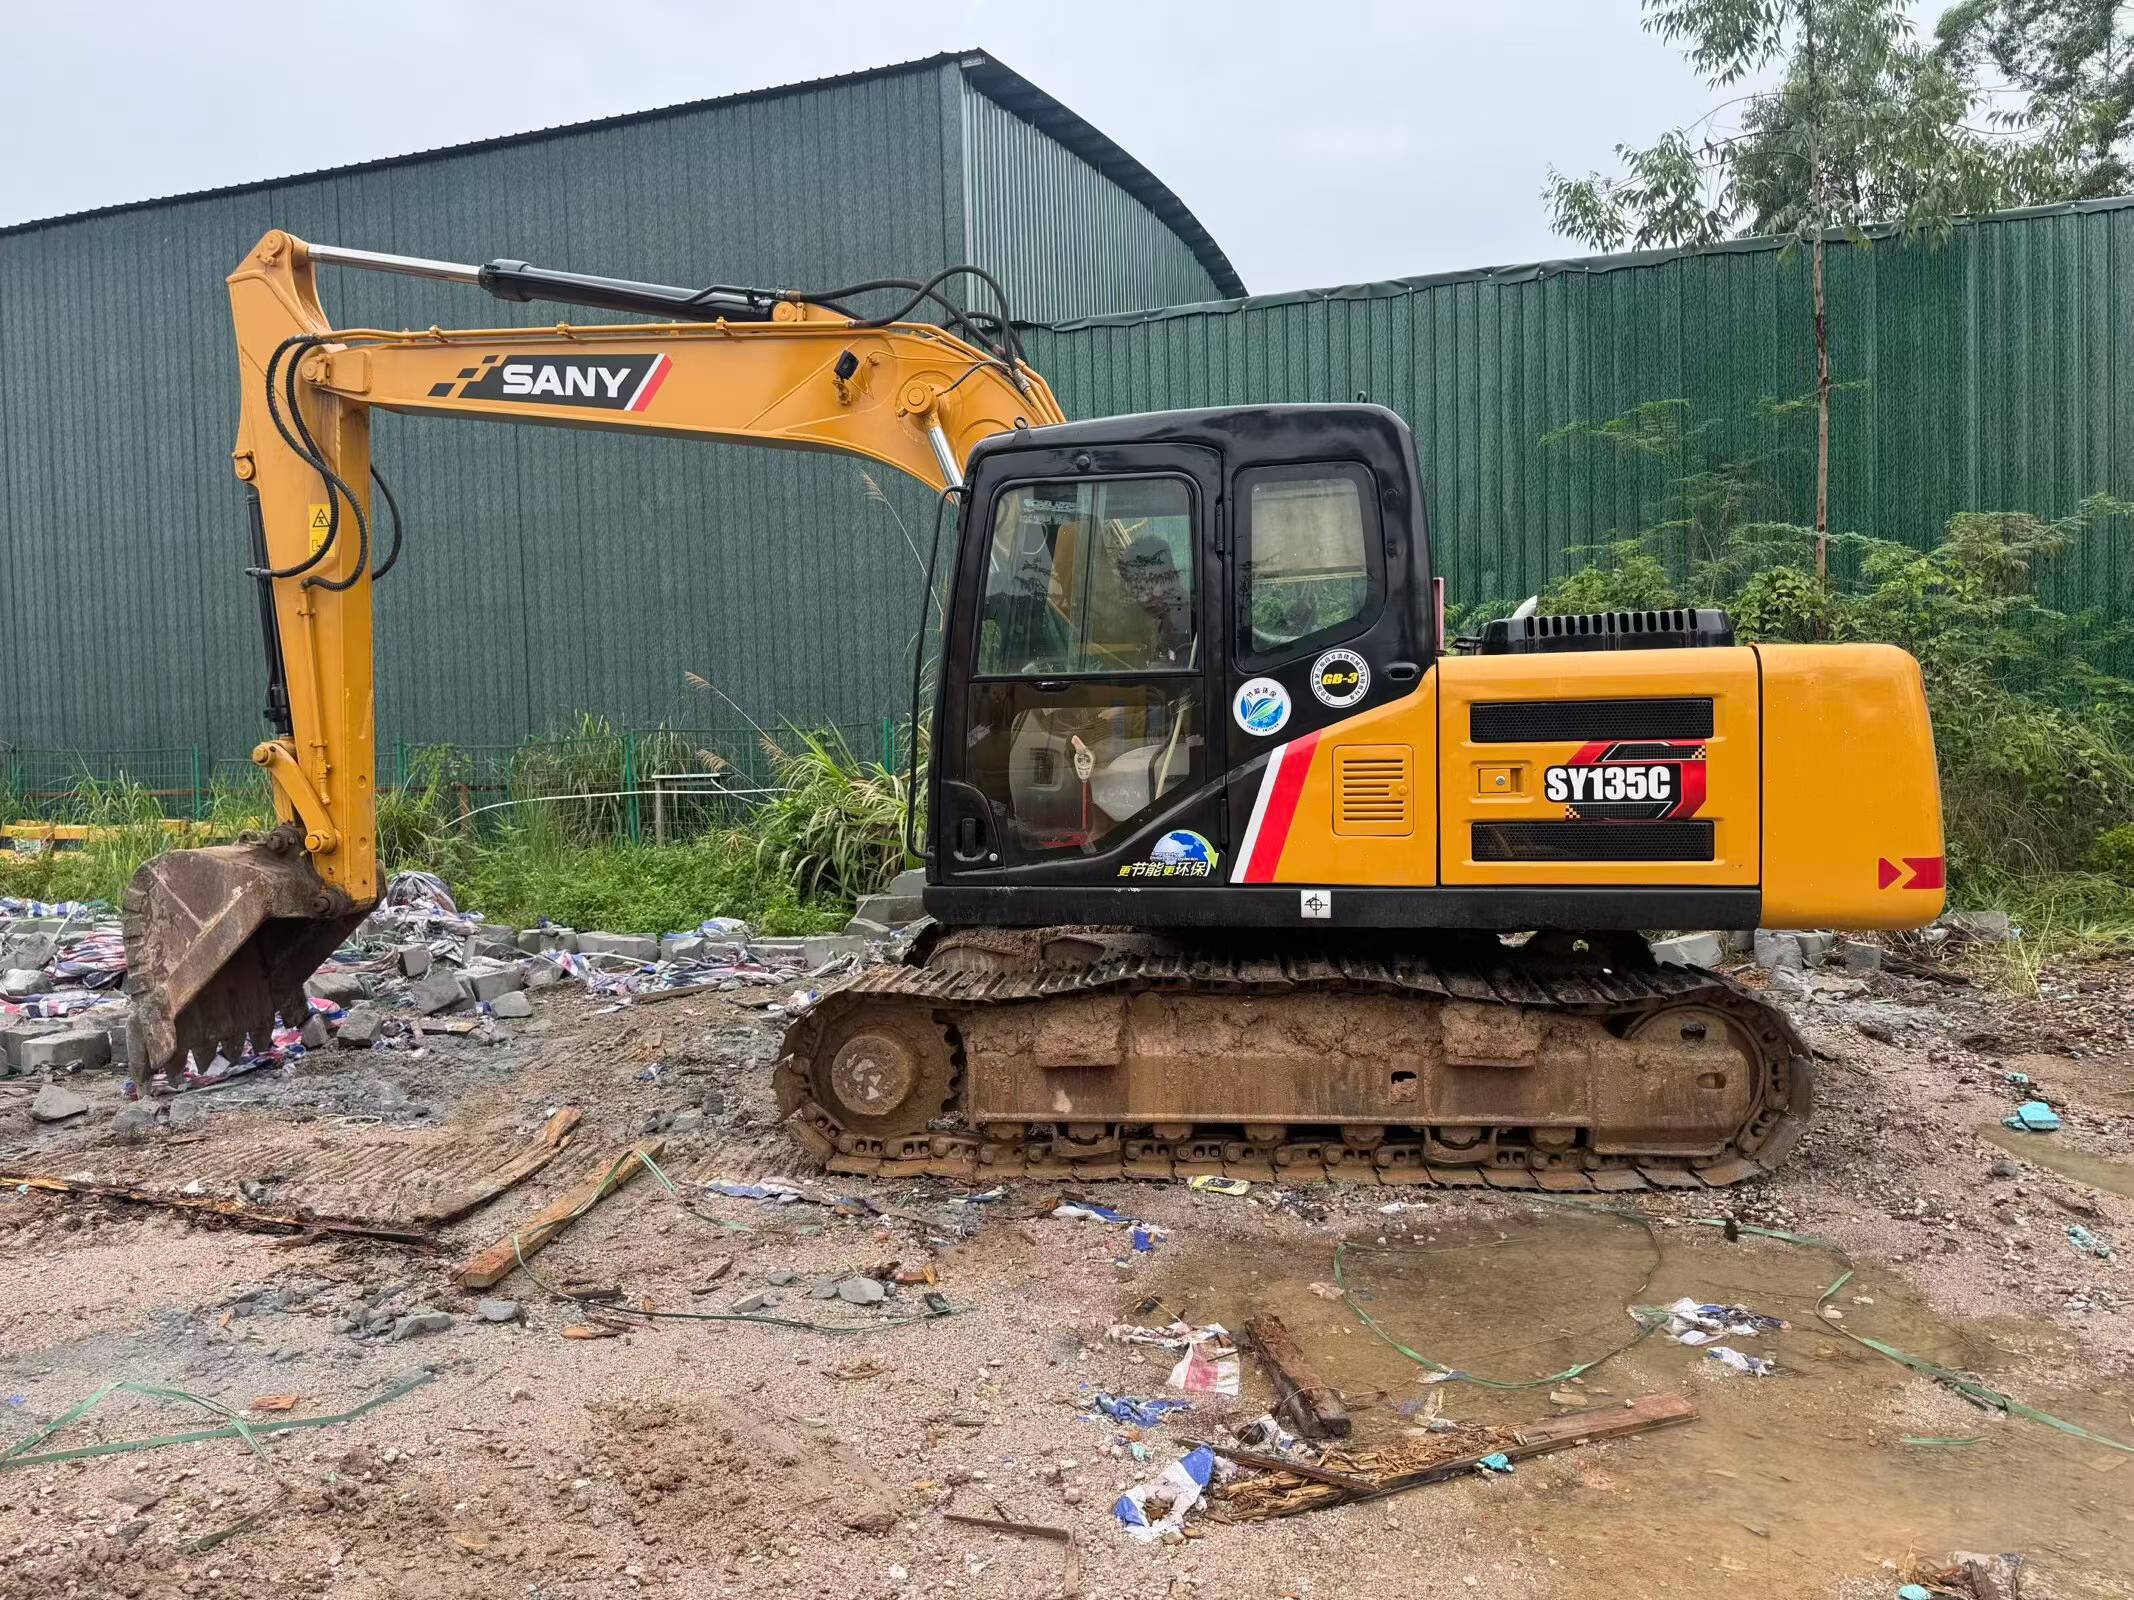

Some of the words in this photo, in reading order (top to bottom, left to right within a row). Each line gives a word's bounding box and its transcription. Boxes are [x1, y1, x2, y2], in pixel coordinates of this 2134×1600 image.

[503, 364, 631, 398] SANY
[1322, 672, 1359, 685] GB-3
[1546, 765, 1671, 801] SY135C
[1117, 861, 1207, 877] 更节能更环保
